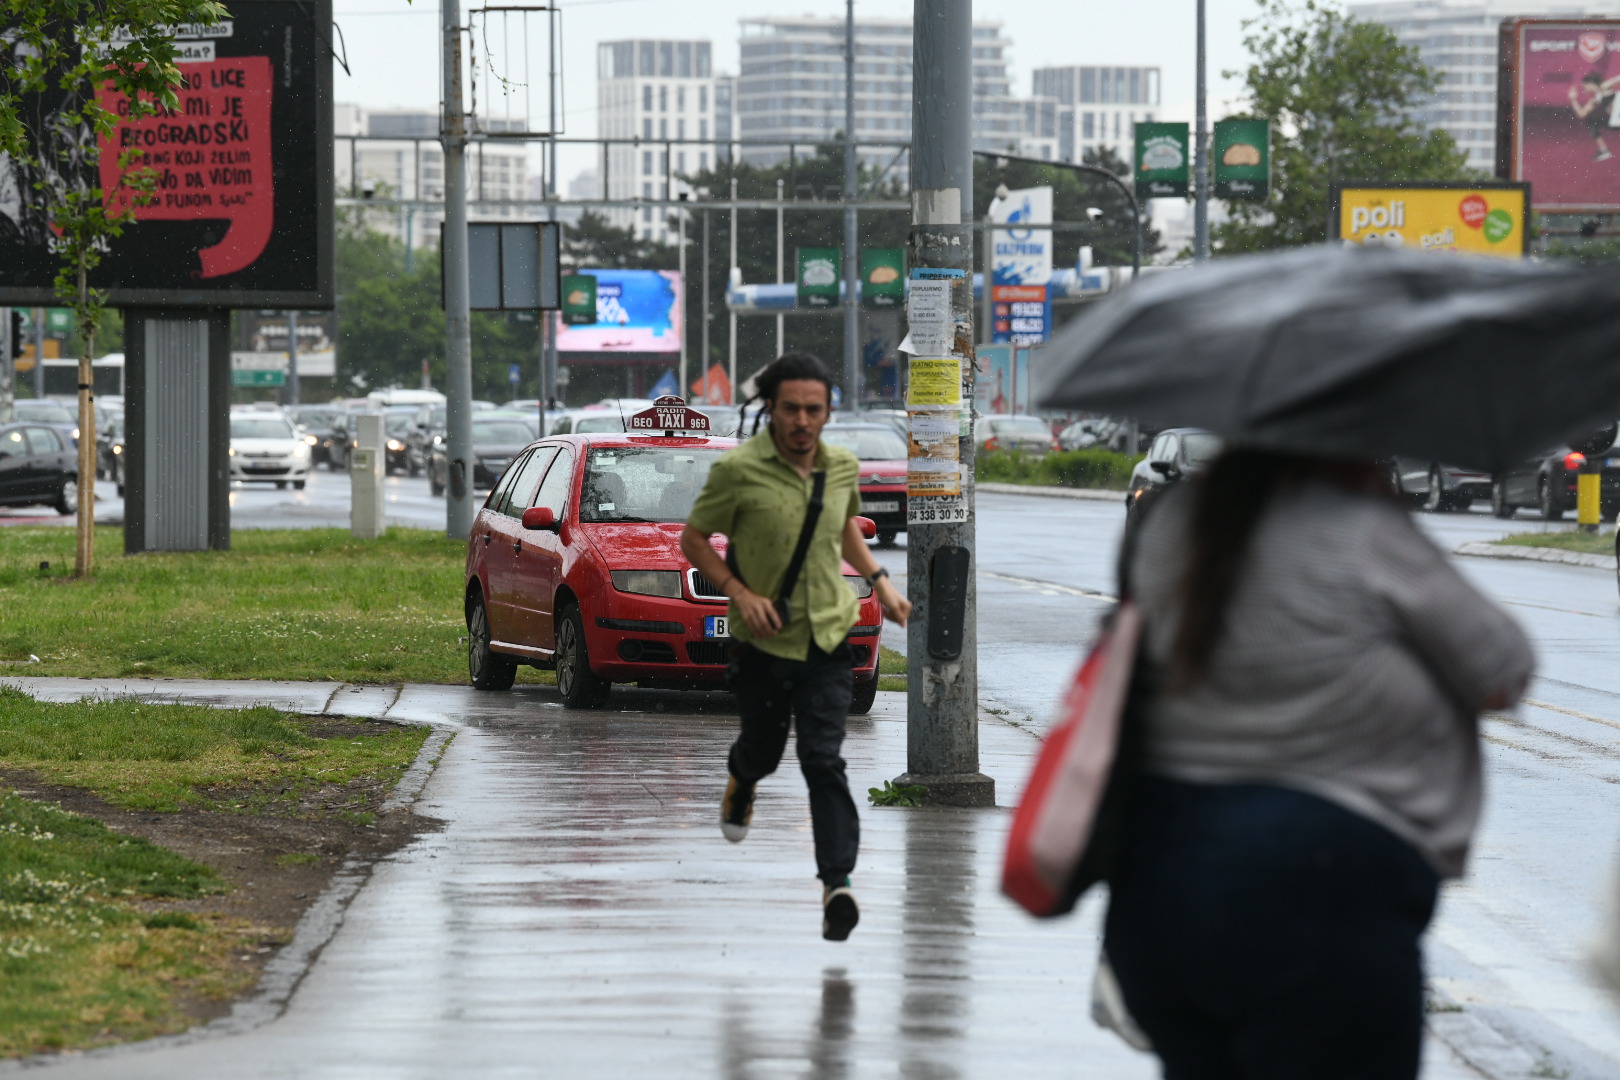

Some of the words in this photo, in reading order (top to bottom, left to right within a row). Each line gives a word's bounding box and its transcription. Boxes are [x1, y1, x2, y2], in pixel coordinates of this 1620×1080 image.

[211, 69, 245, 88] LICE
[221, 97, 243, 117] JE
[185, 171, 204, 188] DA
[1352, 200, 1404, 234] poli
[996, 243, 1044, 256] GAZPROM
[633, 417, 652, 428] BEO
[658, 413, 685, 428] TAXI
[690, 418, 706, 429] 969
[920, 510, 936, 521] 338
[939, 509, 951, 520] 30
[955, 508, 964, 519] 30
